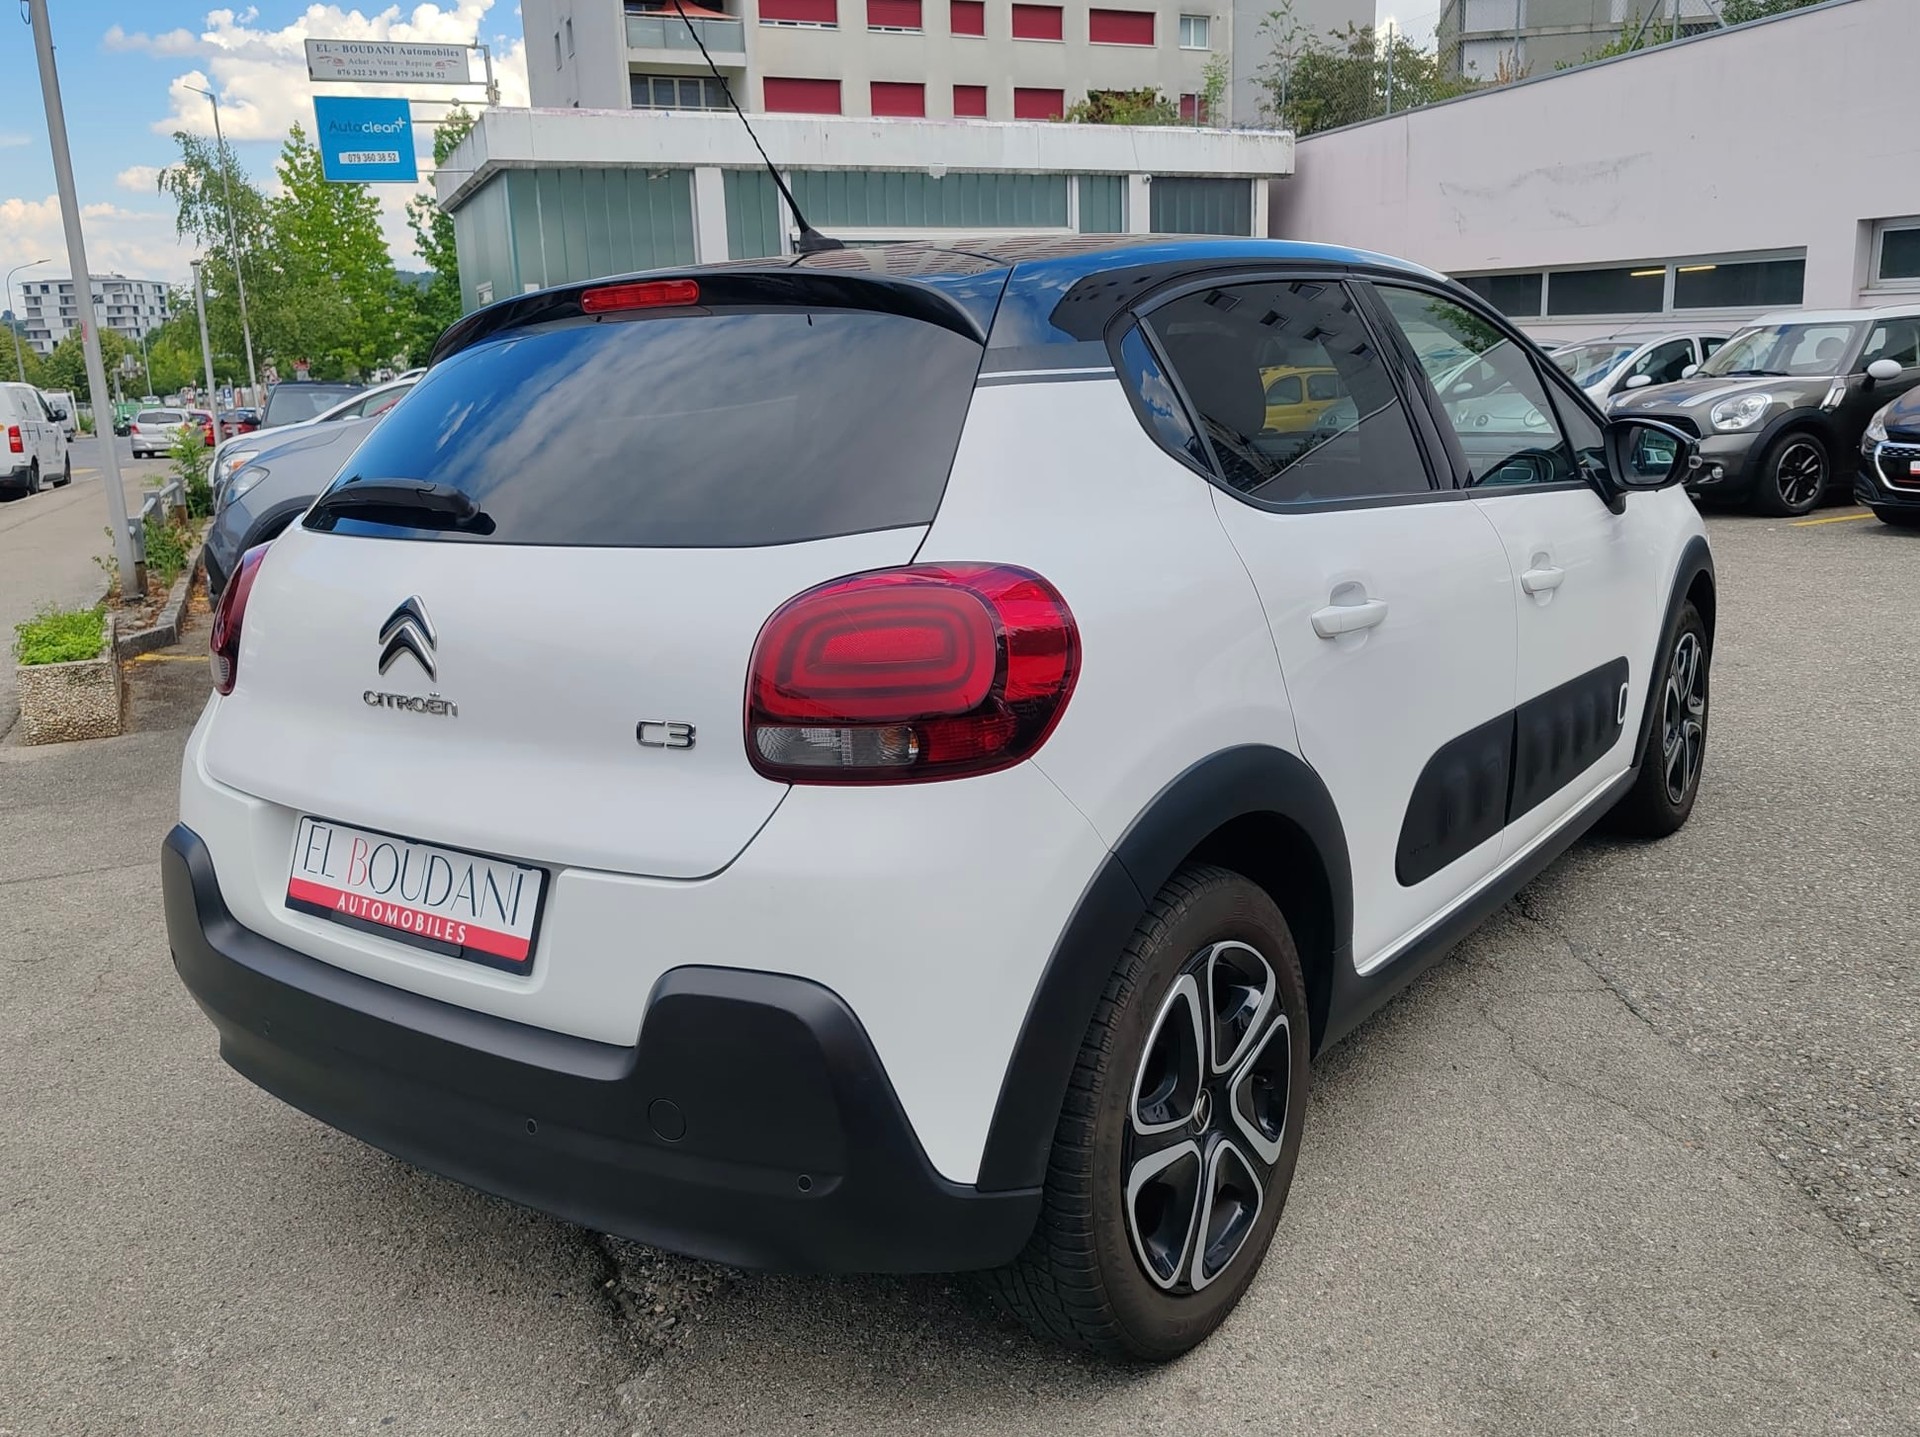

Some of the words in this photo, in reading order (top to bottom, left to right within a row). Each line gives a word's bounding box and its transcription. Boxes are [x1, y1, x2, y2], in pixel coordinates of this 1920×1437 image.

[316, 43, 331, 53] EL
[342, 44, 395, 55] BOUDANI
[400, 47, 459, 57] Automobiles
[376, 58, 398, 66] Vente
[405, 59, 432, 69] Reprise
[436, 71, 446, 79] 52
[348, 153, 361, 163] 079
[362, 153, 376, 162] 360
[377, 152, 387, 162] 38
[388, 152, 397, 162] 52
[636, 719, 697, 750] C3
[303, 824, 335, 879] EL
[347, 837, 524, 926] BOUDANI
[336, 894, 467, 944] AUTOMOBILES
